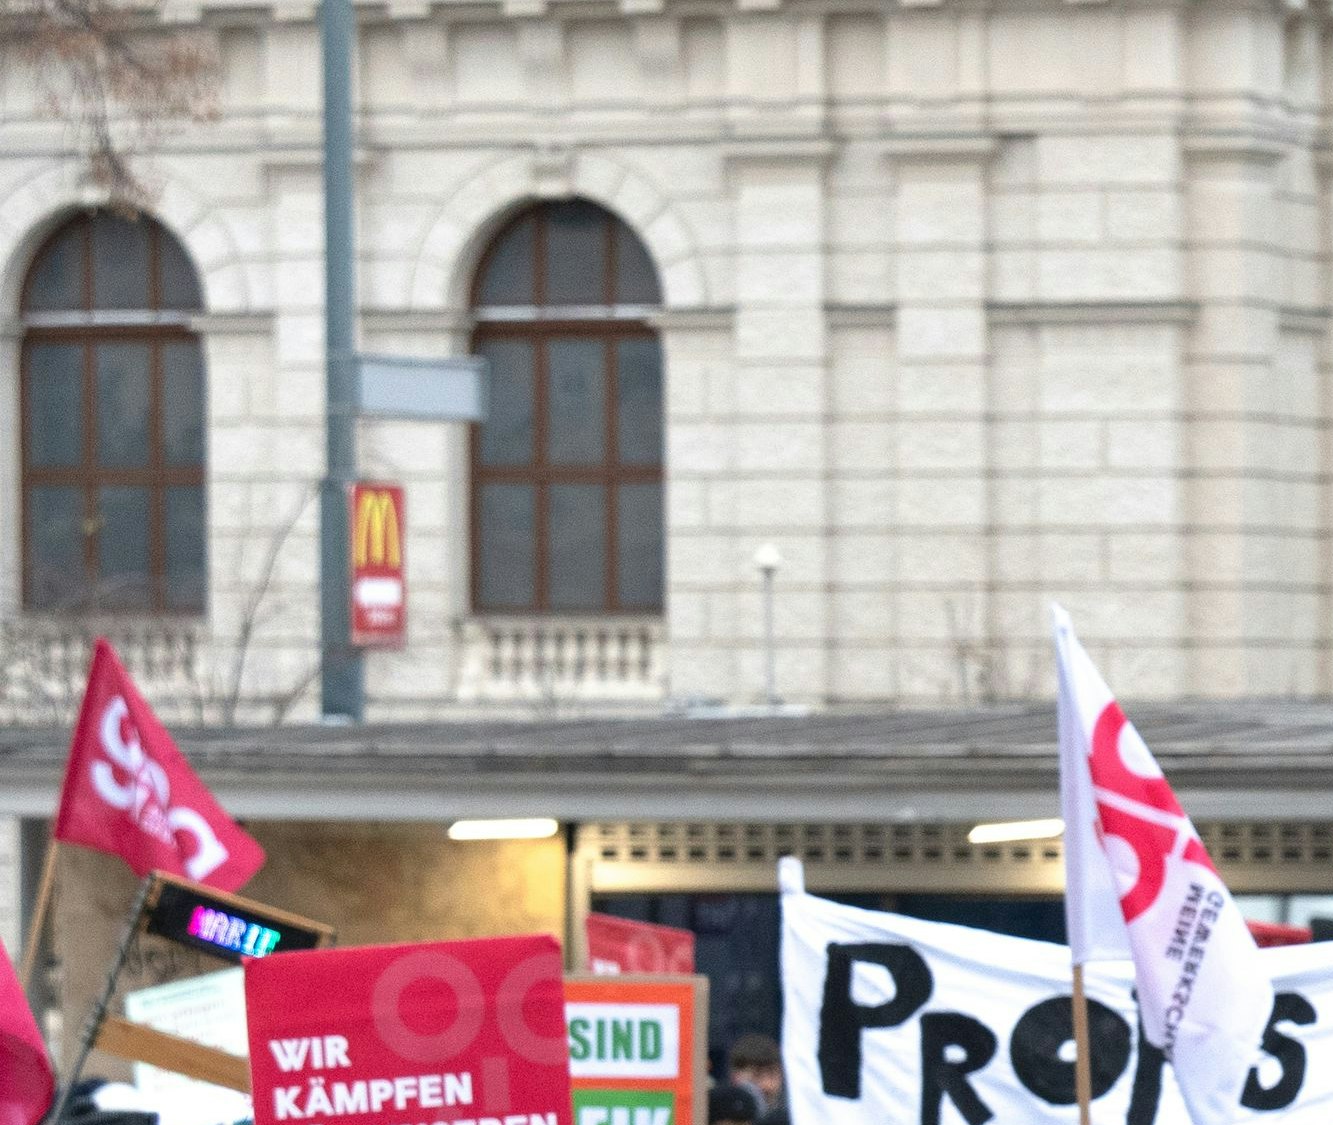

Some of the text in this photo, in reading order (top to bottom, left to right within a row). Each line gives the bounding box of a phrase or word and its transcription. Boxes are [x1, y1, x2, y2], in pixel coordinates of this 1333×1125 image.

[268, 1035, 352, 1072] WIR
[568, 1016, 664, 1063] SIND
[273, 1071, 474, 1120] KÄMPFEN
